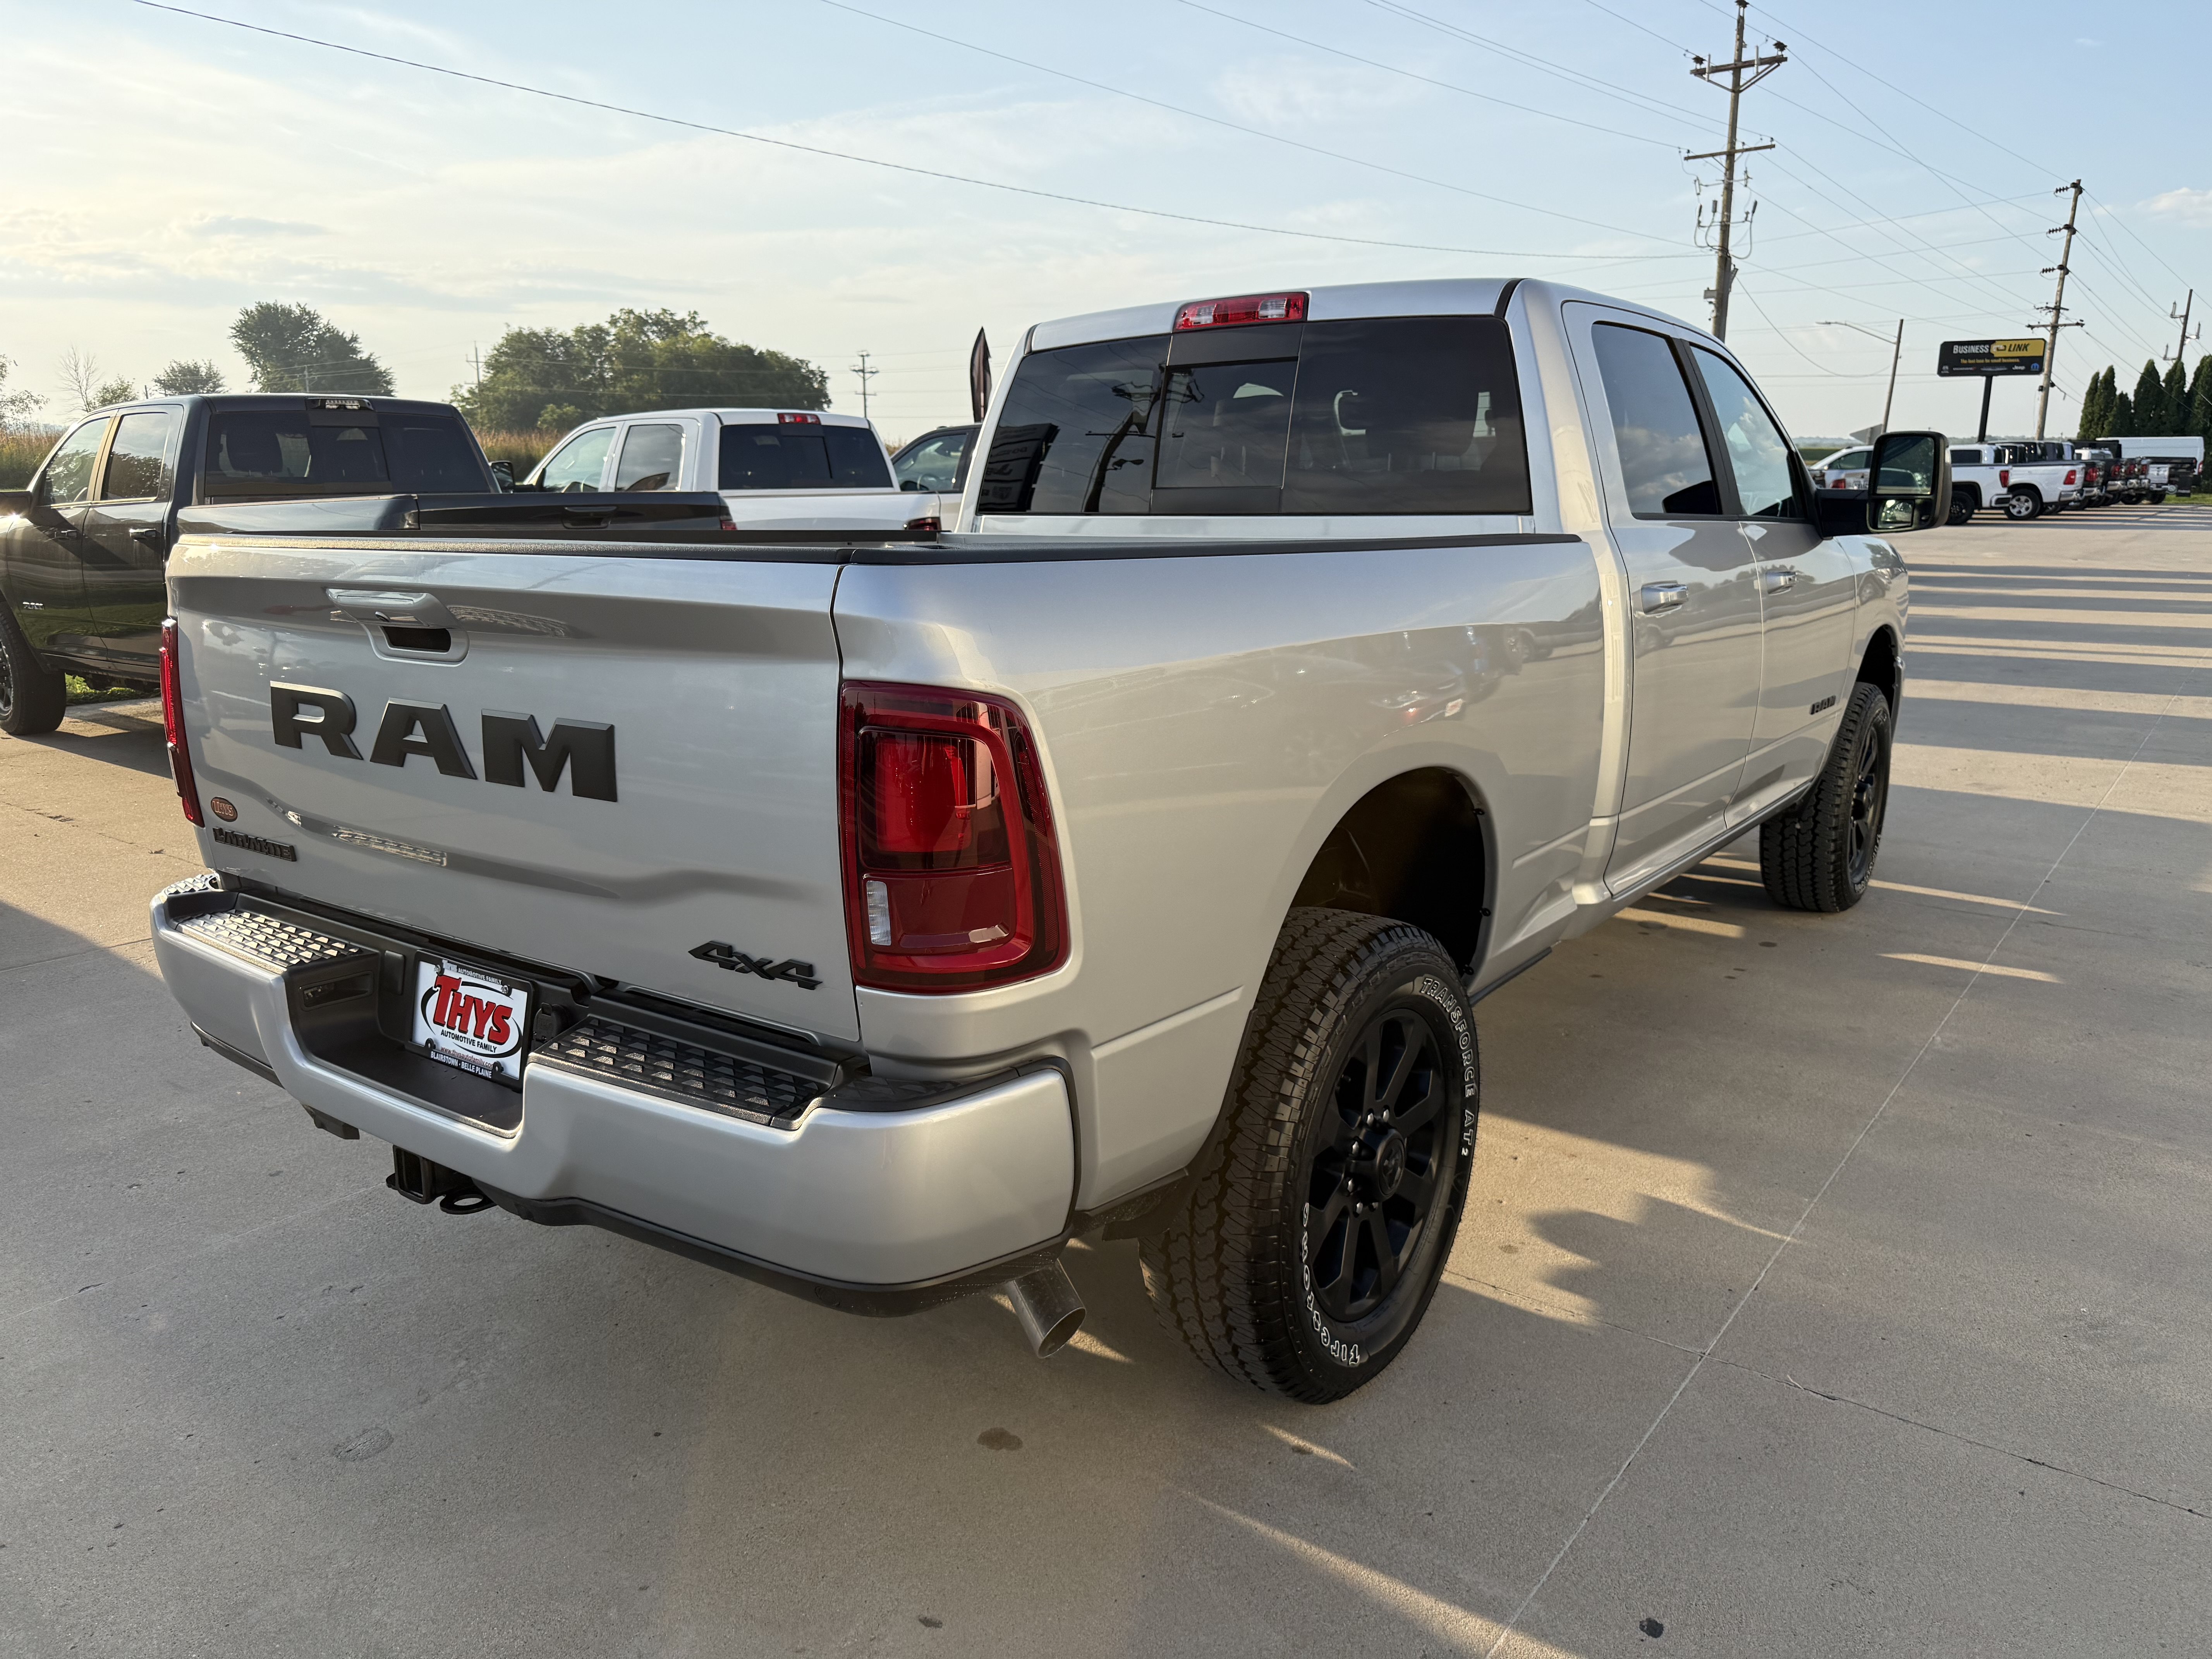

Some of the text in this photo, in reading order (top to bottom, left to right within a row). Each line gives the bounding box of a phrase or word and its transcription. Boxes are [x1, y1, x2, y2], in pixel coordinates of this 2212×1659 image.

[1953, 343, 2029, 354] BUSINESS LINK
[270, 680, 618, 802] RAM
[212, 826, 297, 862] LARAMIE
[458, 968, 486, 981] AUTOMOTIVE
[486, 976, 502, 985] FAMILY
[433, 974, 513, 1046] THYS
[441, 1029, 497, 1053] AUTOMOTIVE FAMILY
[1419, 978, 1475, 1098] TRANSFORCE
[431, 1051, 492, 1079] BLAIRSTOWN BELLE PLAINE
